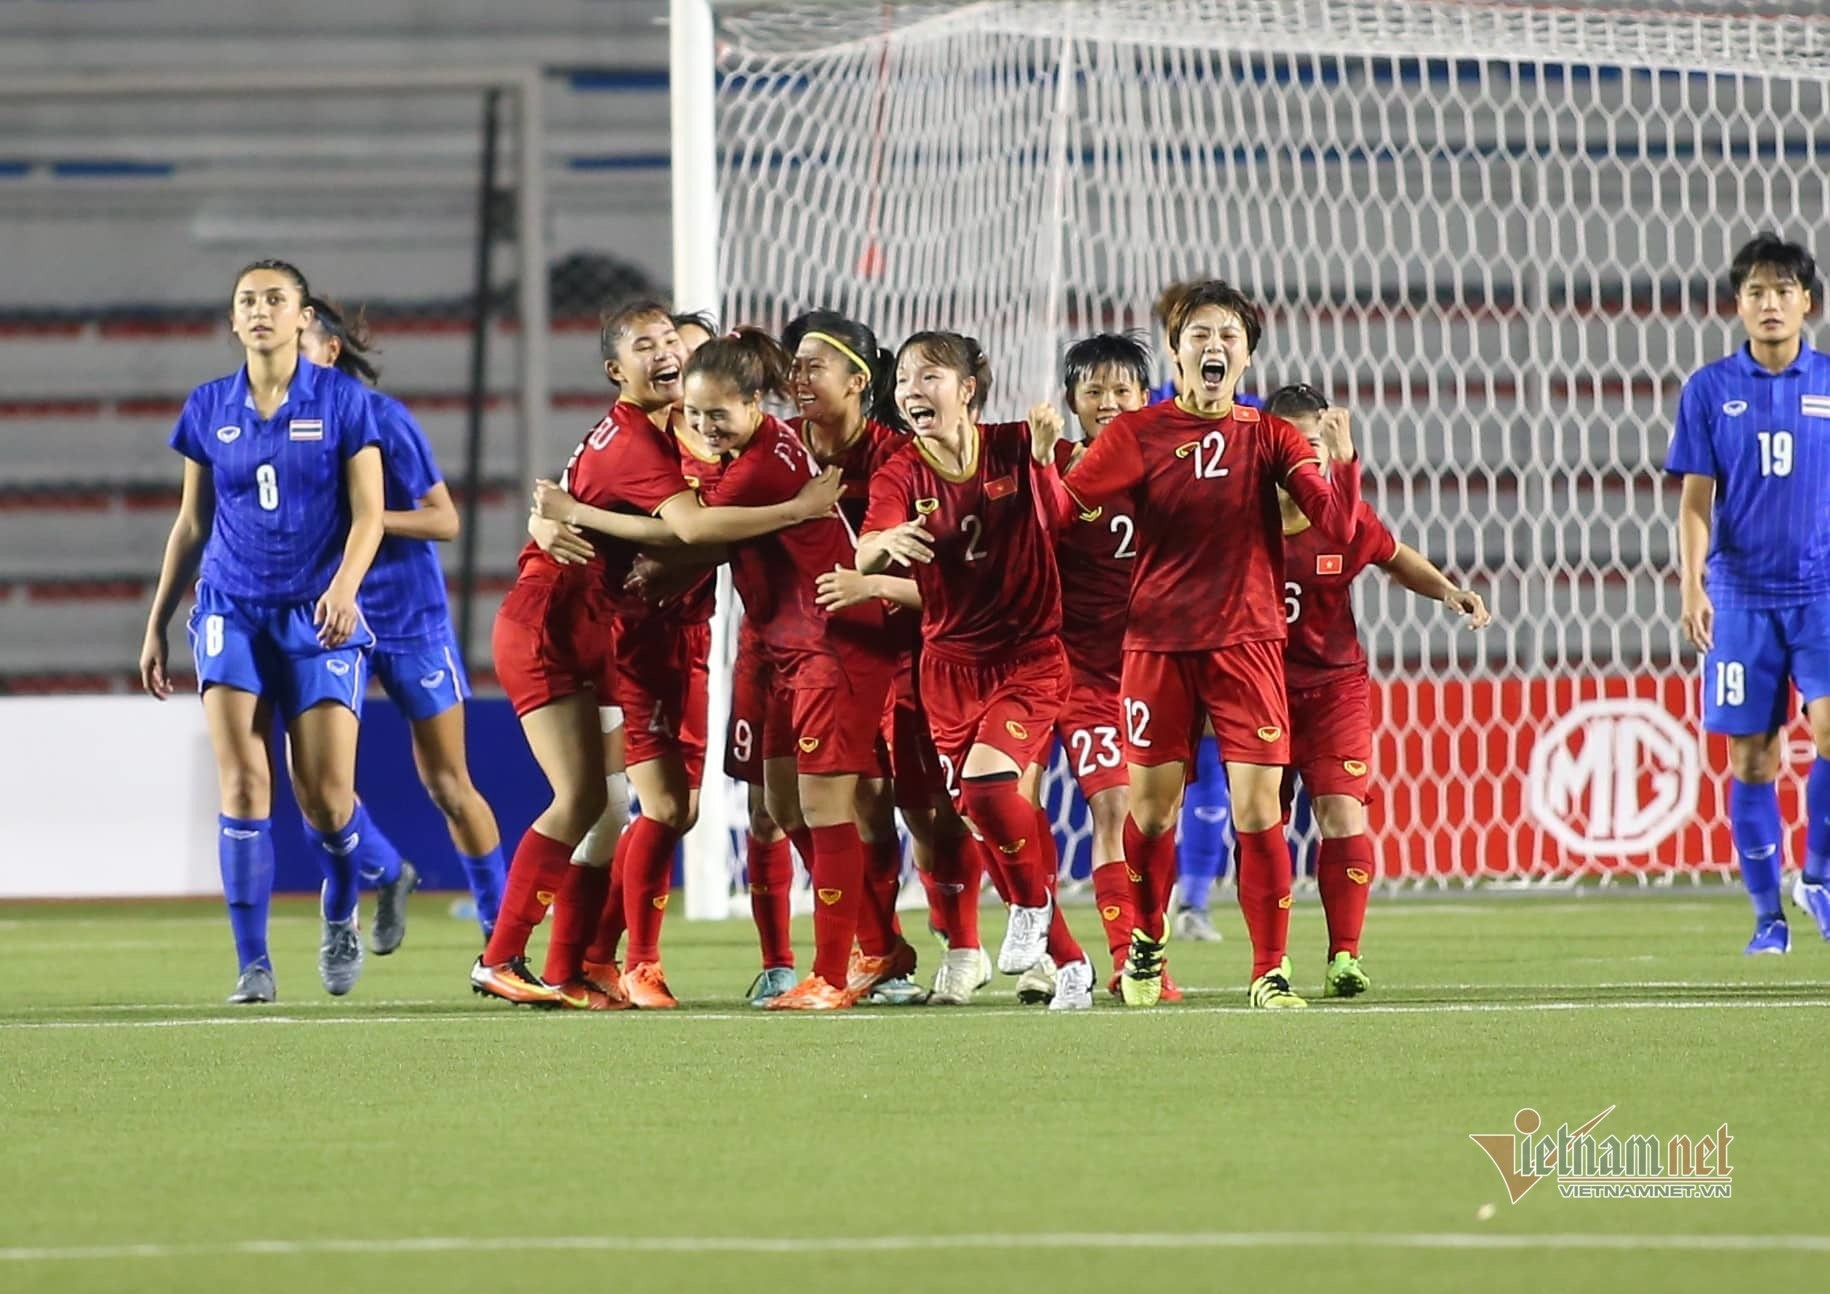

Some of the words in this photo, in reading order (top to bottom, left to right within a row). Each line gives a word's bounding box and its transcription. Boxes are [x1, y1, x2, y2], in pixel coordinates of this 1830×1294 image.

[1191, 431, 1229, 480] 12
[1757, 431, 1793, 477] 19
[256, 464, 279, 511] 8
[961, 515, 988, 561] 2
[1110, 515, 1137, 560] 2
[206, 614, 224, 658] 8
[1716, 661, 1745, 707] 19
[733, 719, 753, 762] 9
[1124, 696, 1152, 748] 12
[1072, 726, 1121, 777] 23
[938, 753, 961, 797] 2
[1550, 715, 1683, 838] MG
